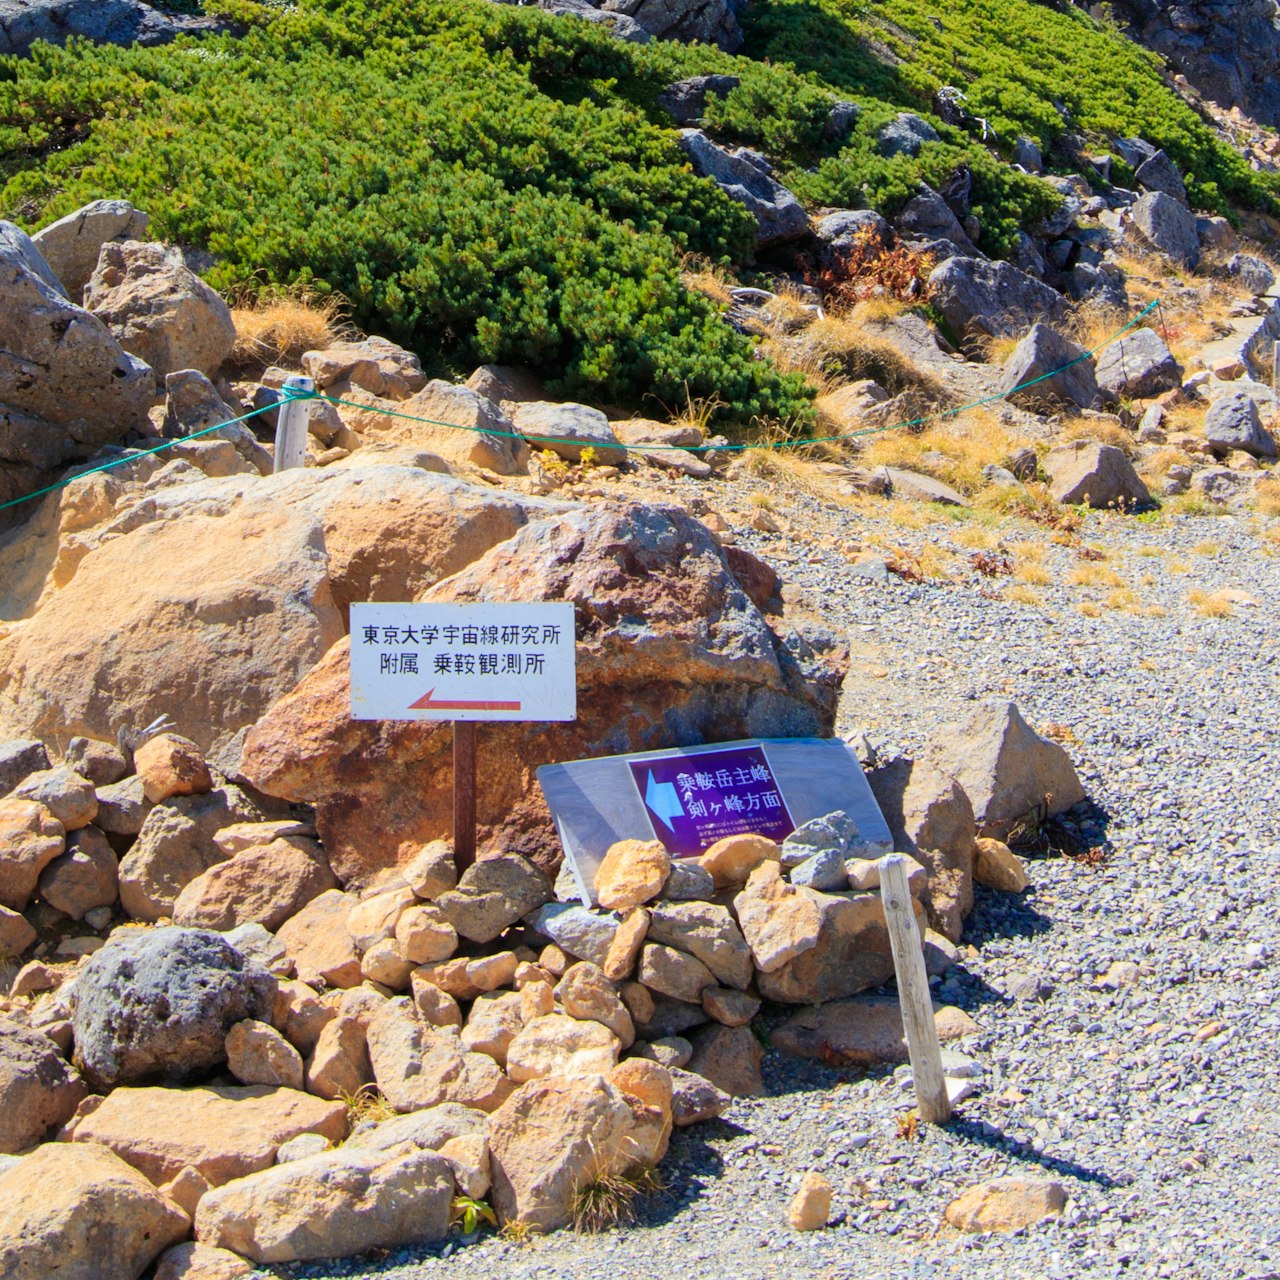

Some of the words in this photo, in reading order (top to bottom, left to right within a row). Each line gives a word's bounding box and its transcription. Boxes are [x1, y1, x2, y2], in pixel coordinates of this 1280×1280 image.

[362, 625, 561, 645] 東京大学宇宙線研究所
[380, 653, 419, 675] 附属
[433, 653, 545, 675] 乗鞍観測所
[677, 765, 771, 792] 乗鞍岳主峰
